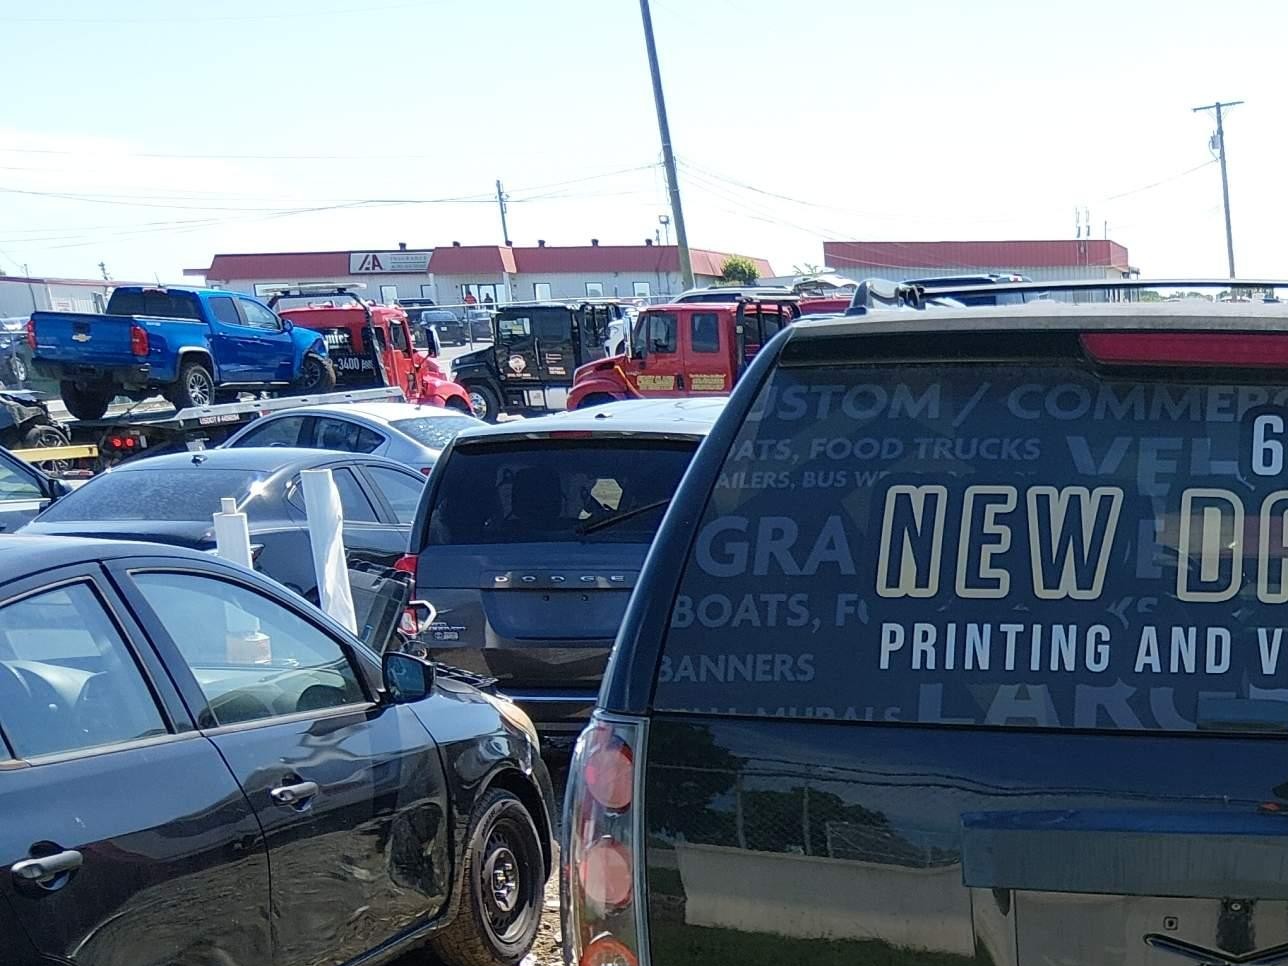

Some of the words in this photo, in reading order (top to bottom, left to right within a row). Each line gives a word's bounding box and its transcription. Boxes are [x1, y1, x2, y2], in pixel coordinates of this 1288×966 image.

[728, 438, 800, 465] ATS,
[809, 437, 905, 461] FOOD
[912, 437, 1042, 461] TRUCKS
[801, 470, 847, 488] BUS
[876, 484, 1124, 600] NEW
[669, 593, 822, 634] BOATS,
[879, 622, 1112, 673] PRINTING
[1134, 624, 1232, 675] AND
[656, 653, 817, 683] BANNERS
